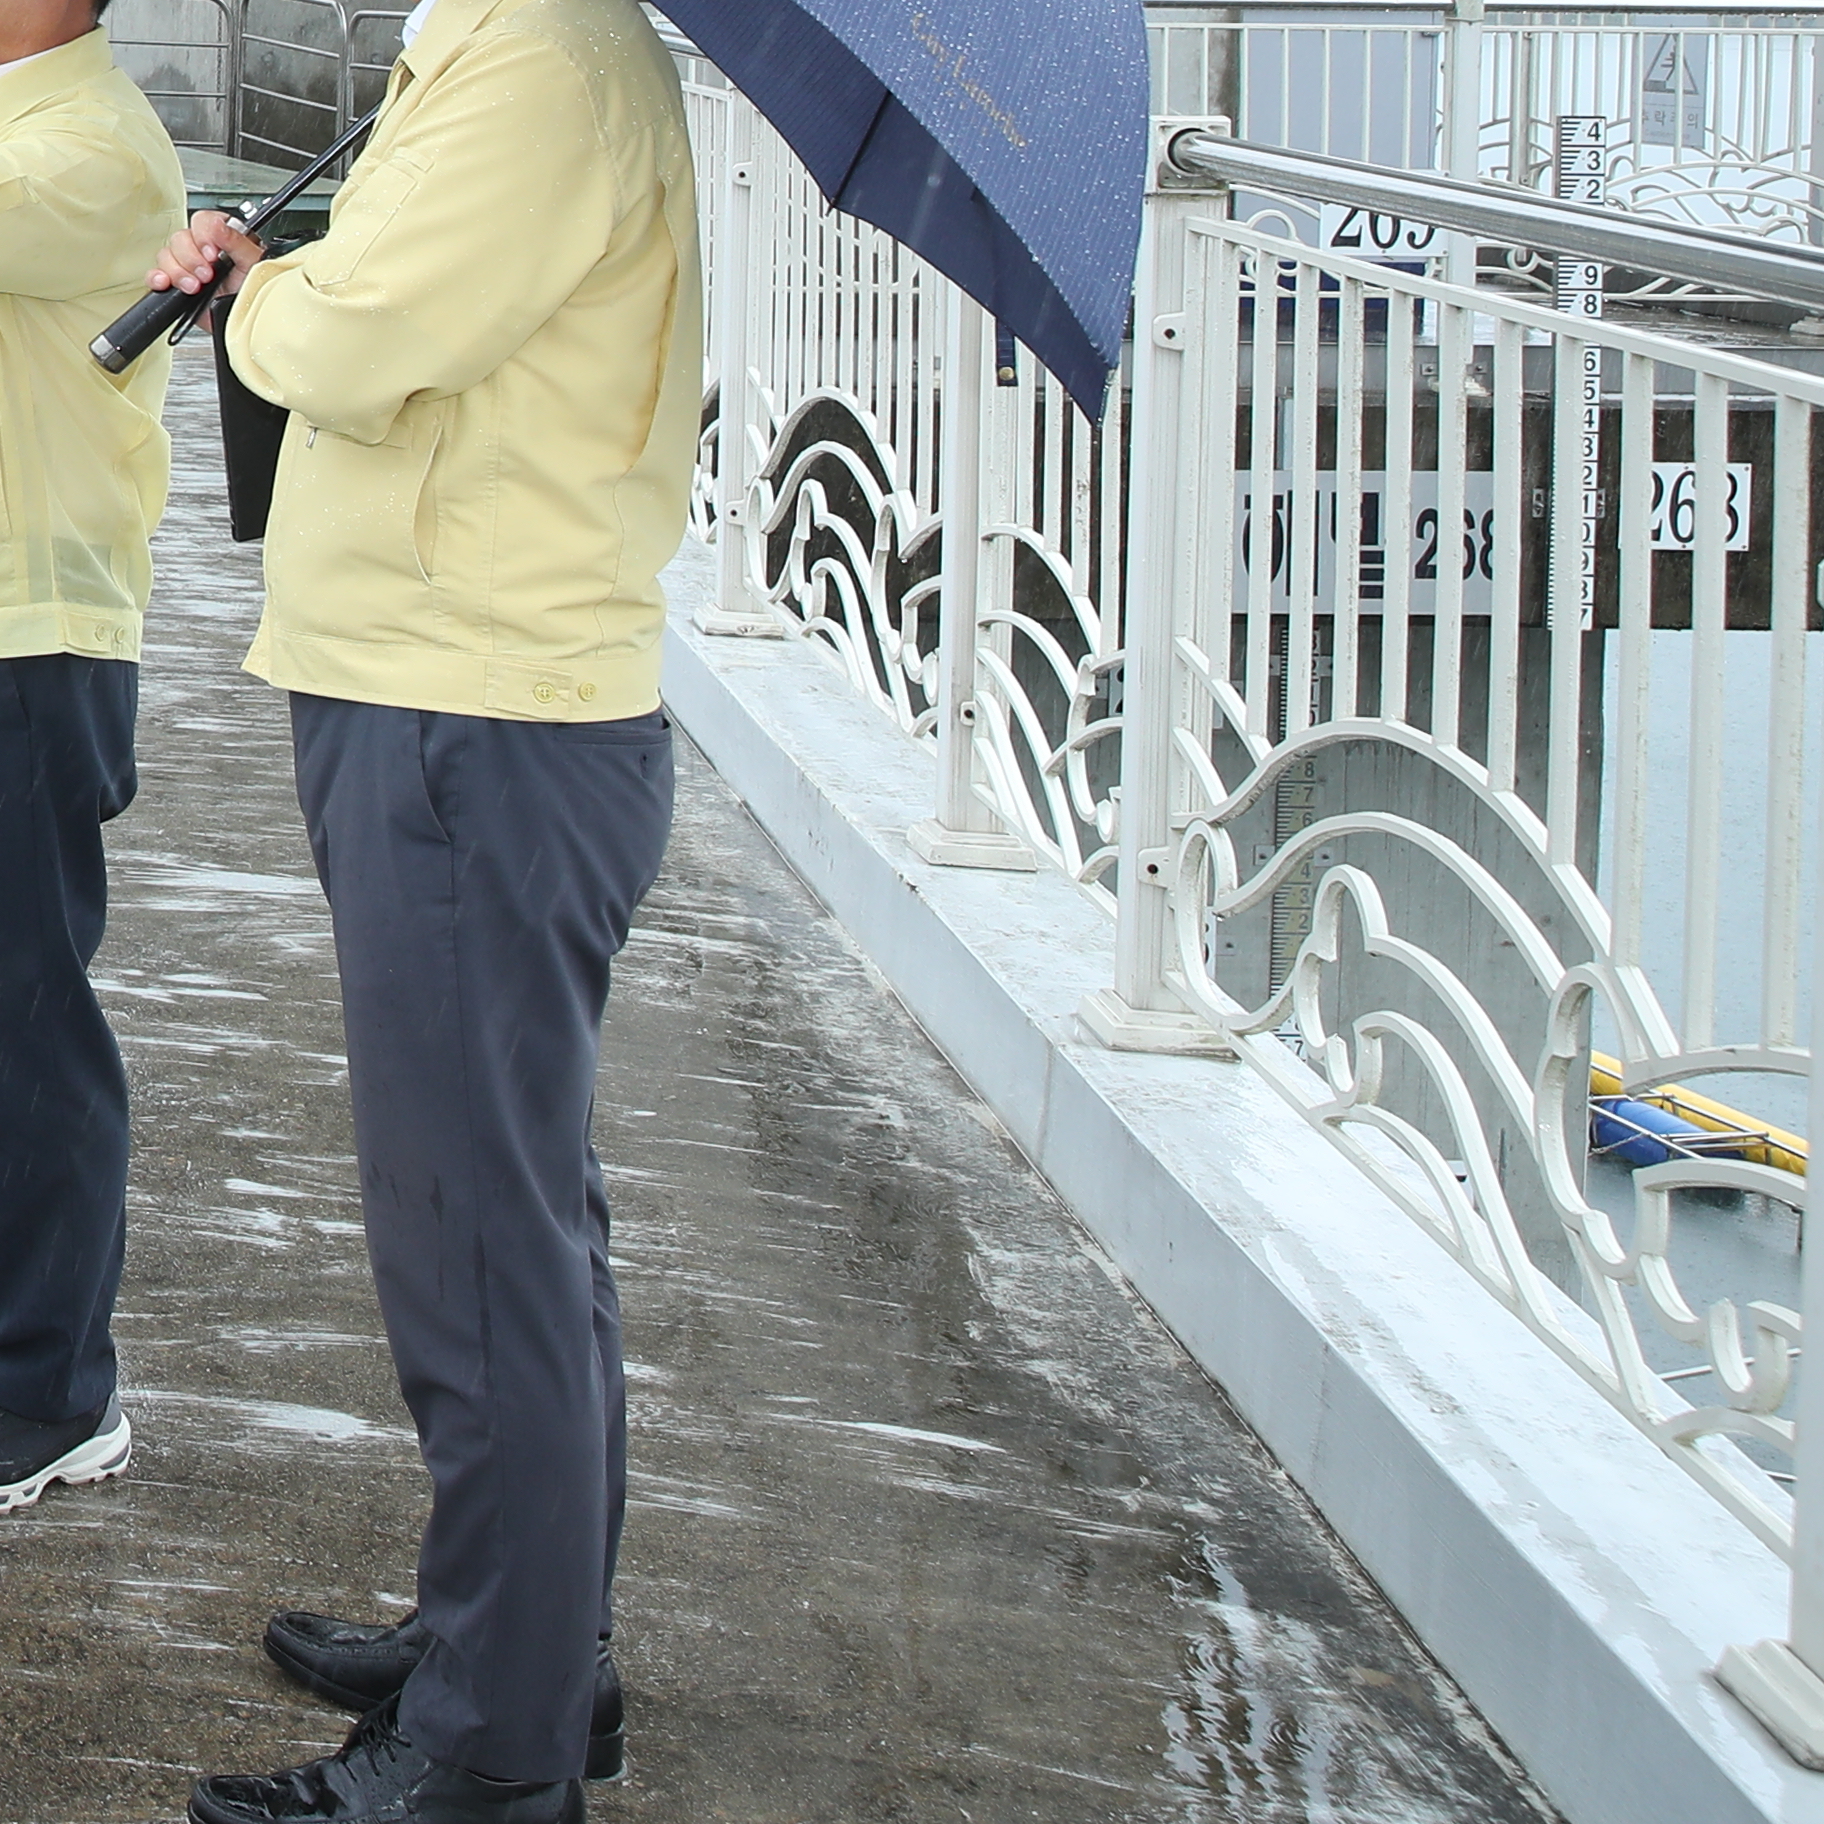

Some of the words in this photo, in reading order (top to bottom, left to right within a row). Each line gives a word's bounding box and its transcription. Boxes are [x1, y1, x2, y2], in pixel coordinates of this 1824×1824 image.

[1587, 121, 1601, 142] 4
[1587, 150, 1601, 171] 3
[1586, 179, 1600, 199] 2
[1584, 265, 1598, 285] 9
[1583, 293, 1597, 314] 8
[1584, 351, 1596, 372] 6
[1583, 380, 1596, 400] 5
[1583, 408, 1595, 428] 4
[1582, 437, 1594, 457] 3
[1582, 465, 1592, 485] 2
[1304, 762, 1314, 777] 8
[1304, 787, 1314, 803] 7
[1300, 862, 1311, 878] 4
[1299, 913, 1308, 928] 2
[1295, 1040, 1304, 1055] 7
